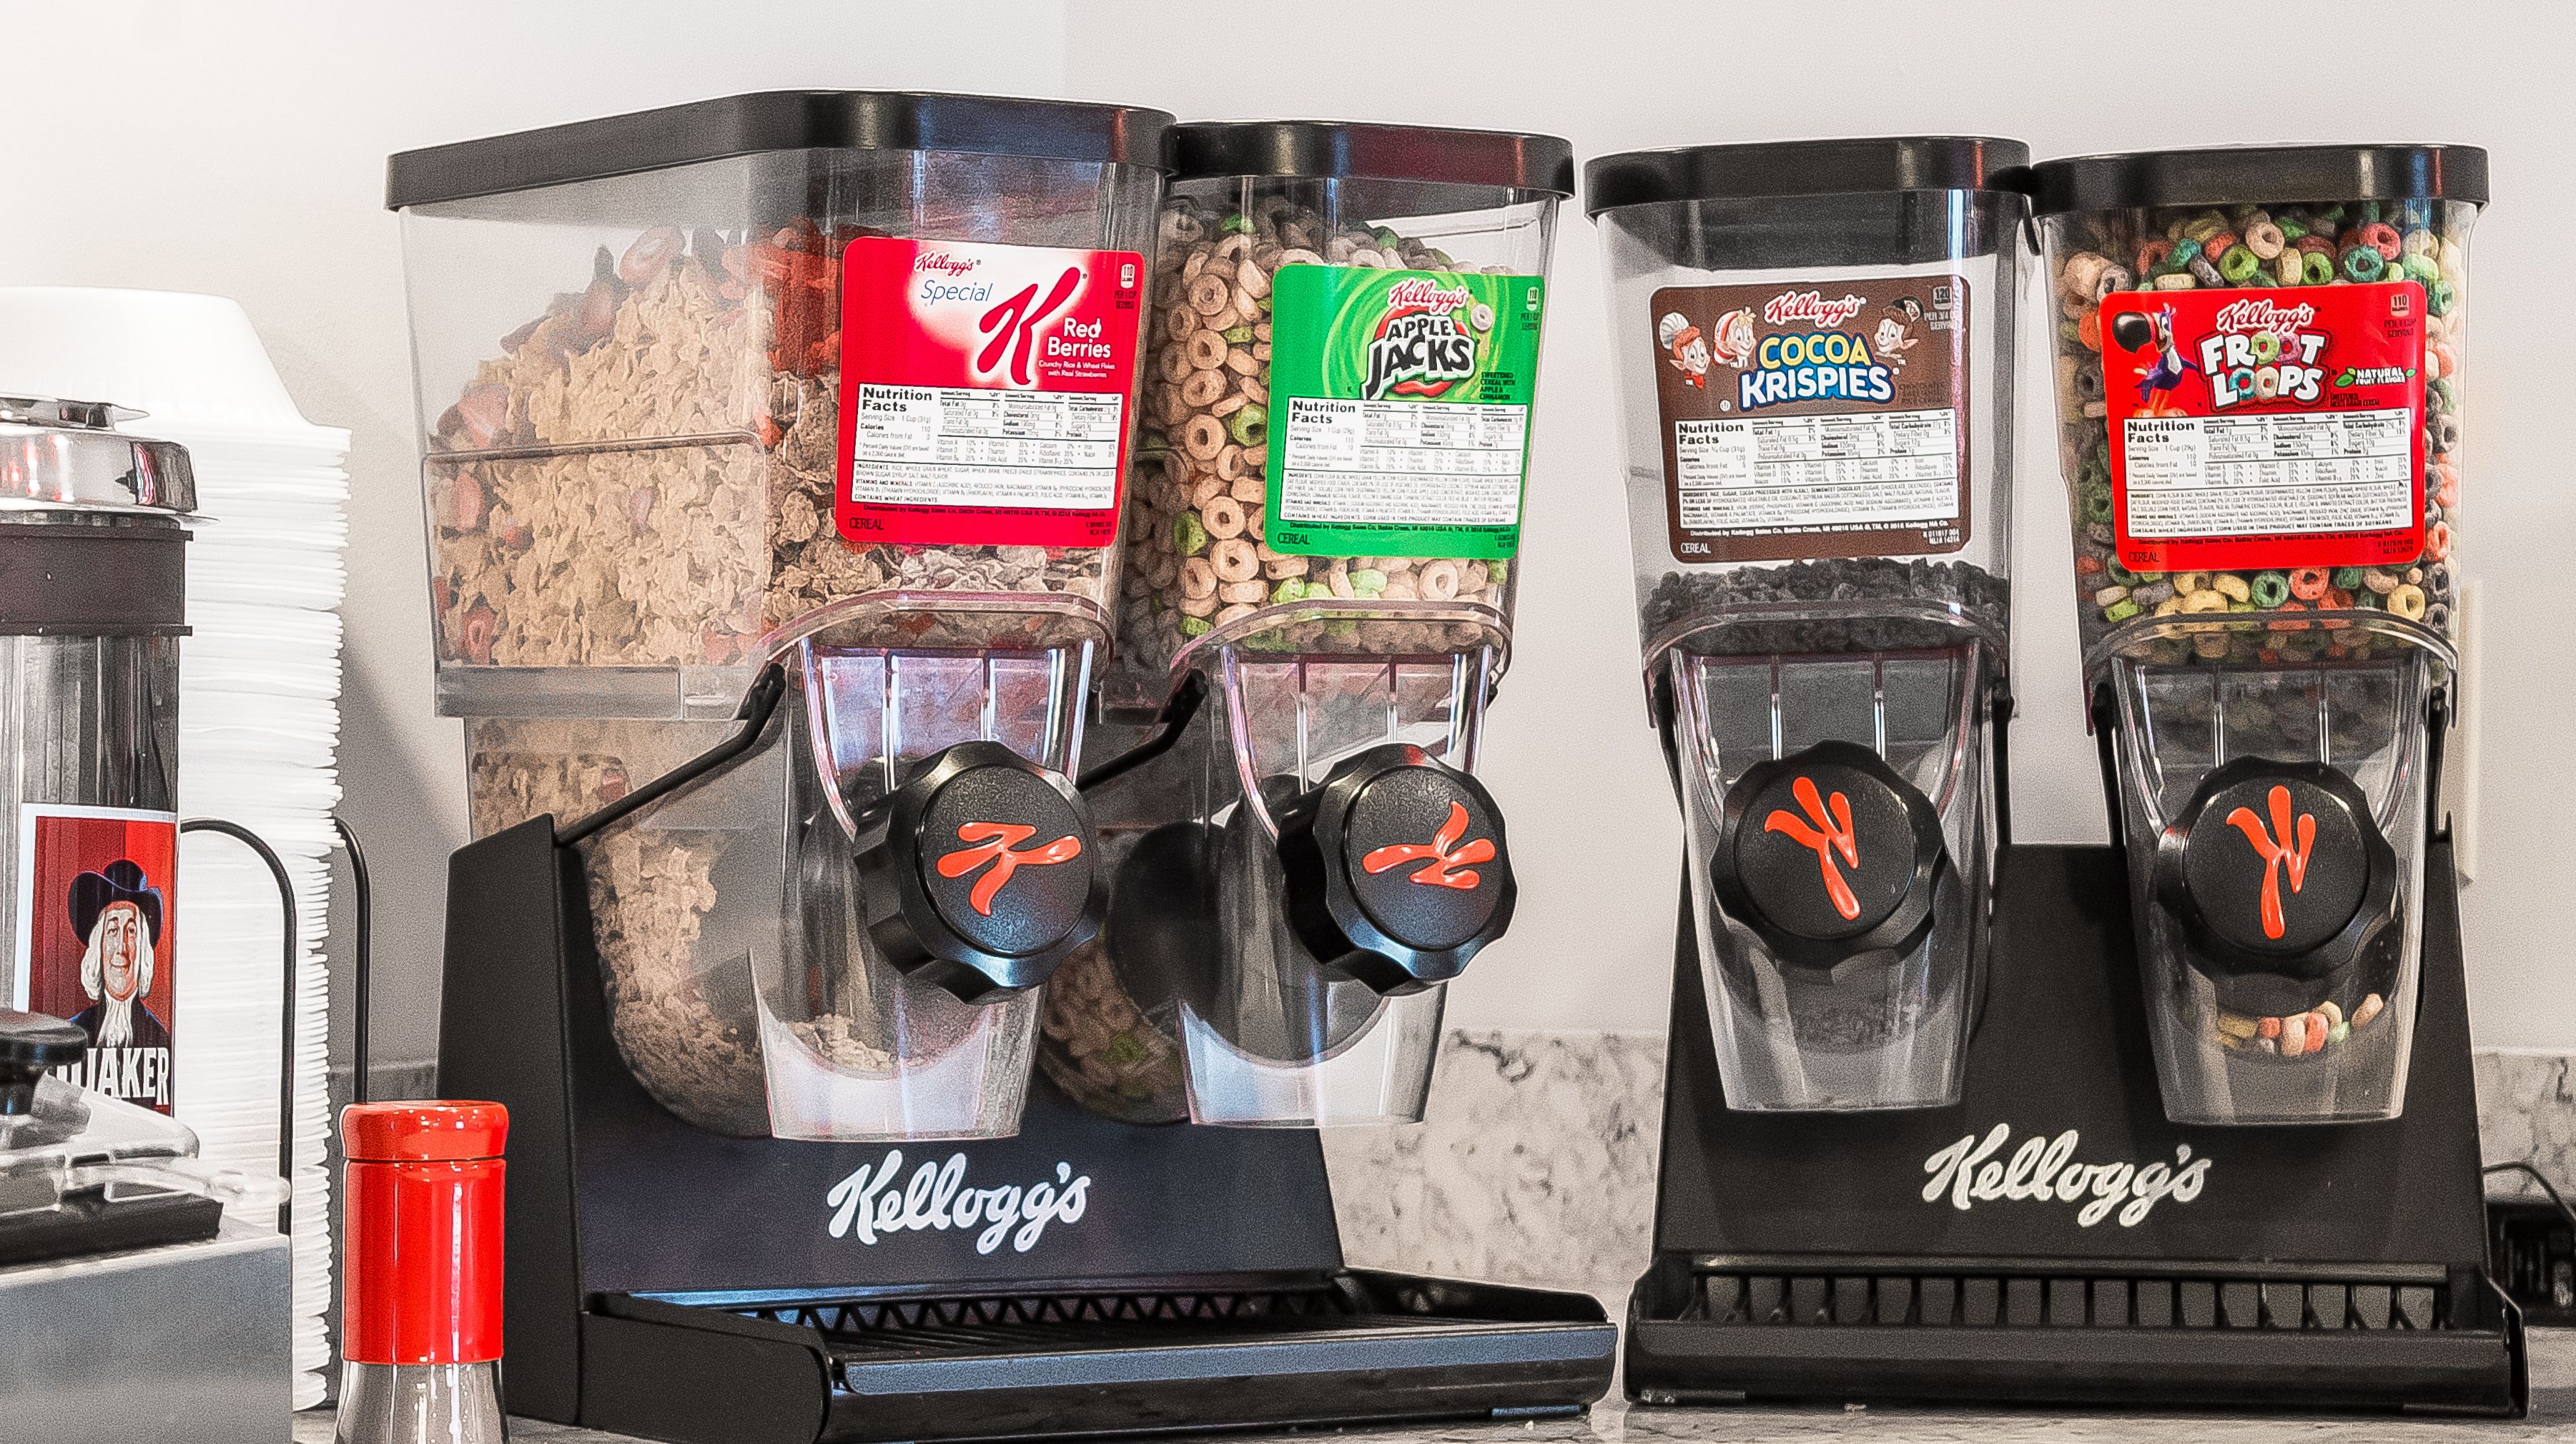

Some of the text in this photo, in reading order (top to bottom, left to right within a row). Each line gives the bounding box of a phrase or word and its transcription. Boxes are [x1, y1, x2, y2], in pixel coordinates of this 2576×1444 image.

[916, 252, 974, 277] Kellogg's
[1390, 280, 1466, 313] Kellogg's
[1935, 288, 1950, 299] 120
[2394, 295, 2407, 306] 110
[1766, 293, 1857, 325] Kellogg's
[2219, 300, 2312, 333] Kellogg's
[921, 267, 1080, 385] Special K
[1063, 317, 1102, 338] Red
[1386, 318, 1451, 342] APPLE
[1047, 336, 1111, 358] Berries
[1759, 334, 1872, 370] COCOA
[2200, 330, 2325, 375] FROOT
[1365, 334, 1471, 400] JACKS
[2357, 367, 2404, 379] NATURAL
[862, 386, 932, 401] Nutrition
[1741, 365, 1892, 408] KRISPIES
[2213, 365, 2323, 408] LOOPS
[862, 399, 907, 411] Facts
[1292, 400, 1356, 412] Nutrition
[861, 413, 882, 421] Serving
[1291, 412, 1333, 423] Facts
[2128, 420, 2194, 432] Nutrition
[1678, 421, 1744, 433] Nutrition
[1679, 433, 1719, 444] Facts
[2128, 431, 2169, 443] Facts
[849, 516, 884, 530] CEREAL
[1277, 532, 1311, 545] CEREAL
[1680, 542, 1712, 554] CEREAL
[2128, 551, 2159, 562] CEREAL
[56, 1047, 169, 1106] UAKER
[1921, 1122, 2212, 1228] Kellogg's
[826, 1149, 1091, 1255] Kellogg's
